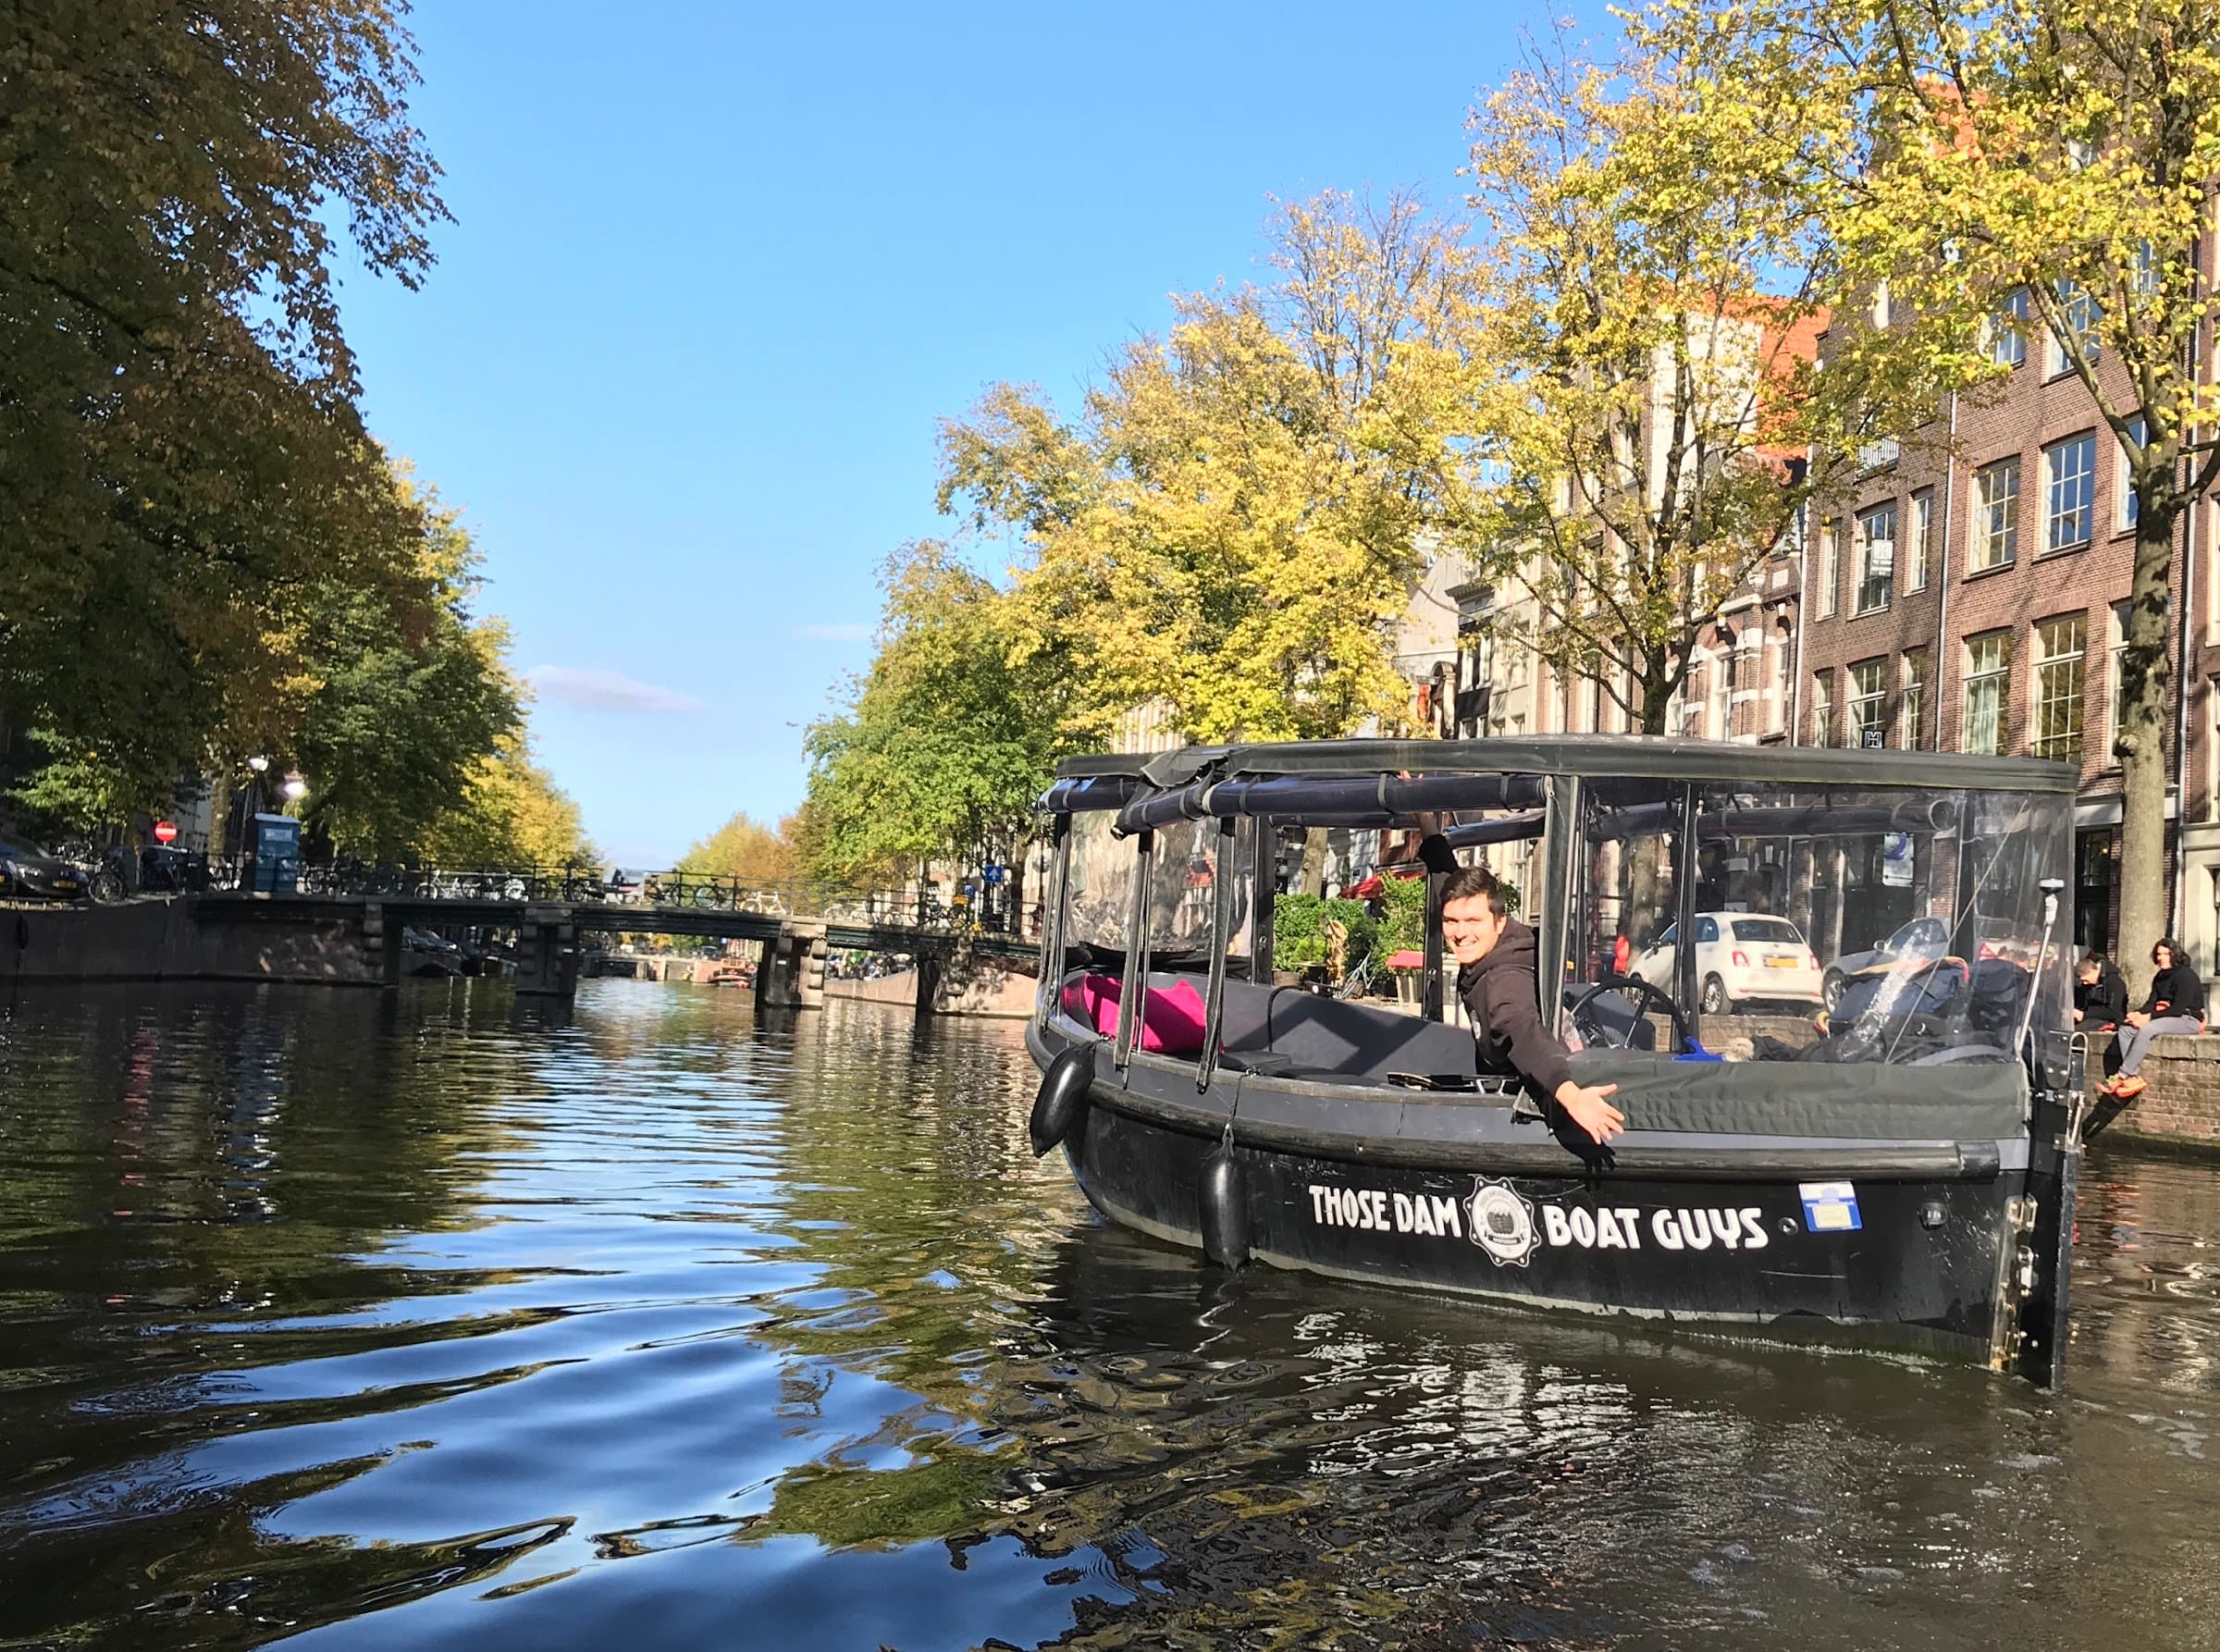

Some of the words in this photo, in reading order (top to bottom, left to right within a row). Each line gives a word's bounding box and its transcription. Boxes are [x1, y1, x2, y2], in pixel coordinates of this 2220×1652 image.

[1308, 1185, 1390, 1231] THOSE
[1392, 1192, 1462, 1238] DAM
[1542, 1204, 1641, 1249] BOAT
[1651, 1207, 1769, 1251] GUYS
